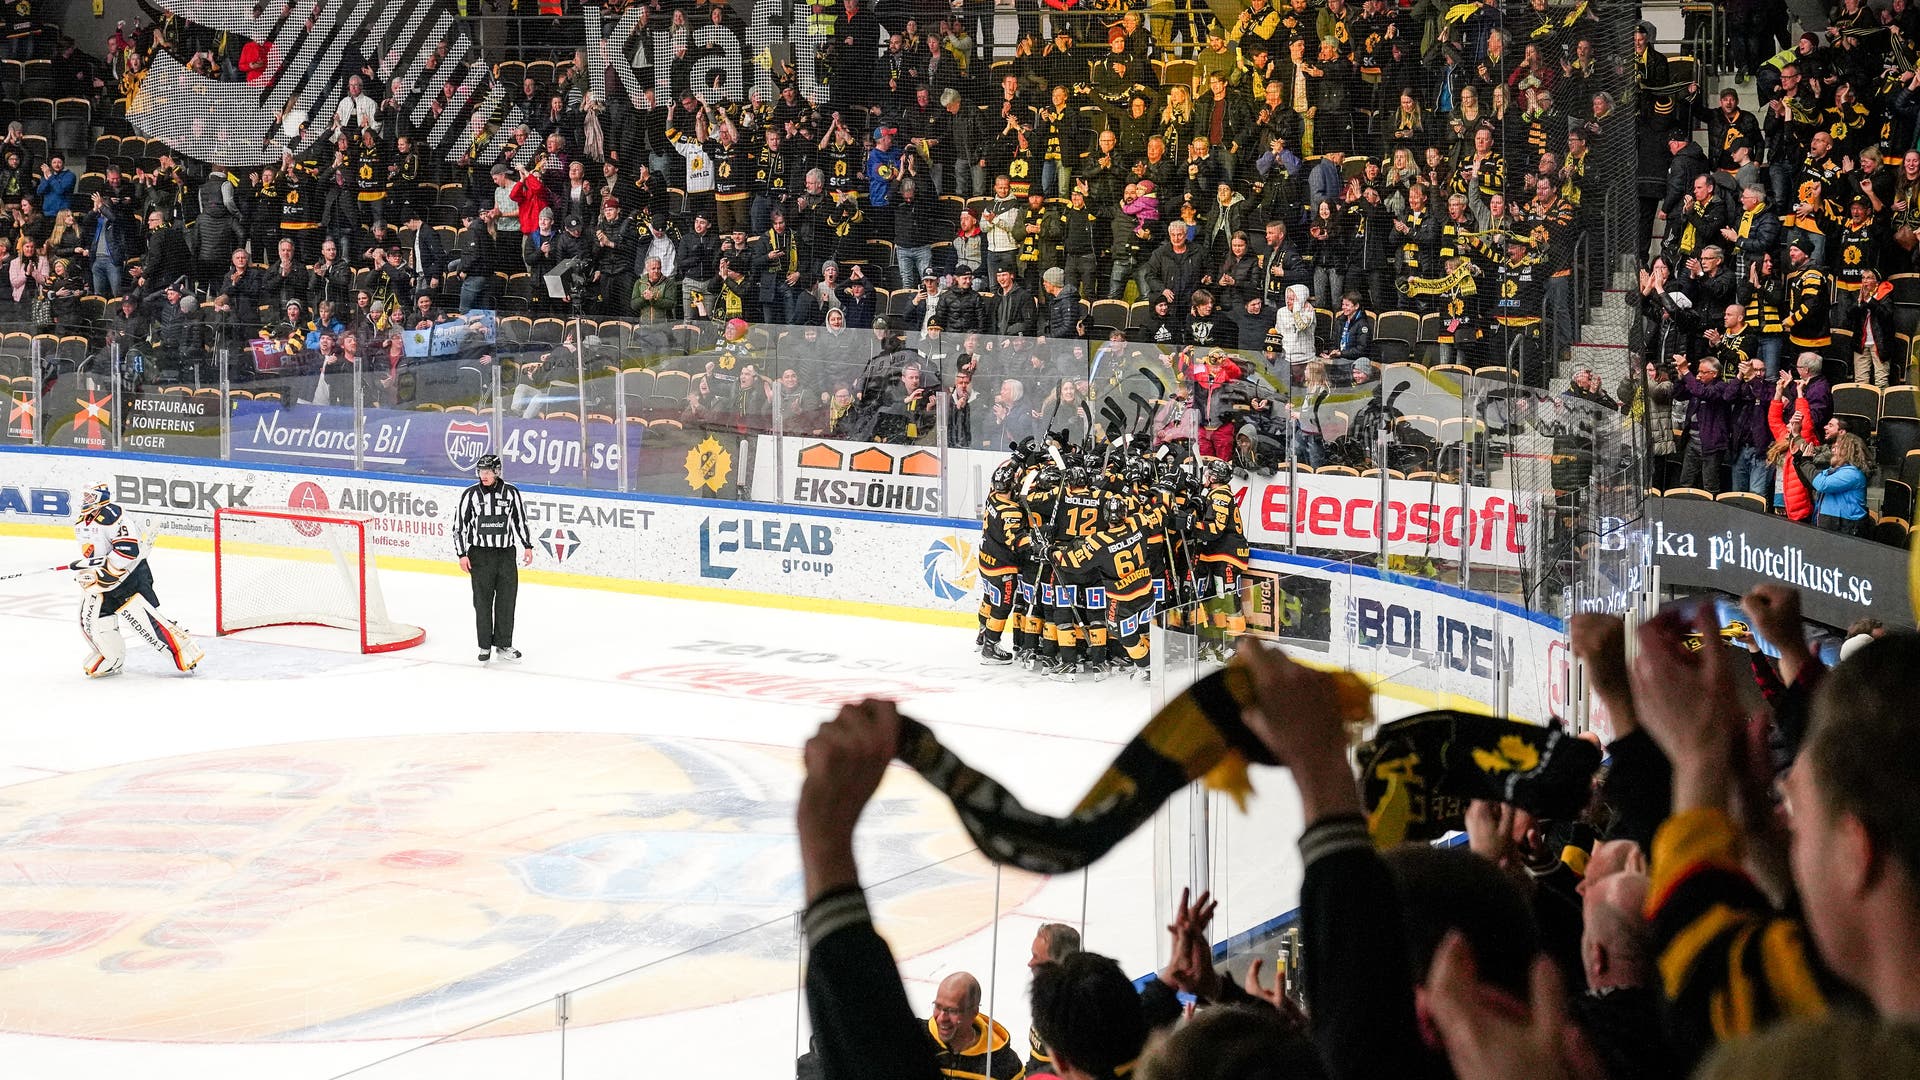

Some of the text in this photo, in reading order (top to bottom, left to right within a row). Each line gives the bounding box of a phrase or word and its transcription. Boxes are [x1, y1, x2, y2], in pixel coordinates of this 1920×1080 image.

[583, 0, 830, 110] Kraft
[134, 399, 205, 415] RESTAURANG
[132, 416, 195, 432] KONFERENS
[374, 418, 411, 454] Bil
[73, 436, 107, 446] RINKSIDE
[130, 435, 165, 448] LOGER
[449, 435, 484, 463] 4Sign
[114, 474, 254, 510] BROKK
[338, 487, 439, 518] AllOffice
[793, 477, 942, 513] EKSJÖHUS
[374, 517, 444, 537] RSVARUHUS
[524, 500, 655, 530] GTEAMET
[1065, 507, 1098, 536] 12
[1261, 483, 1530, 554] Elecosoft
[372, 535, 410, 548] loffice.se
[743, 519, 834, 556] LEAB
[782, 558, 834, 577] group
[1113, 543, 1146, 580] 61
[1600, 516, 1873, 606] Bka på hotellkust.se
[120, 609, 168, 652] SMEDERNA-1
[1358, 597, 1514, 689] BOLIDEN
[669, 638, 840, 665] zero
